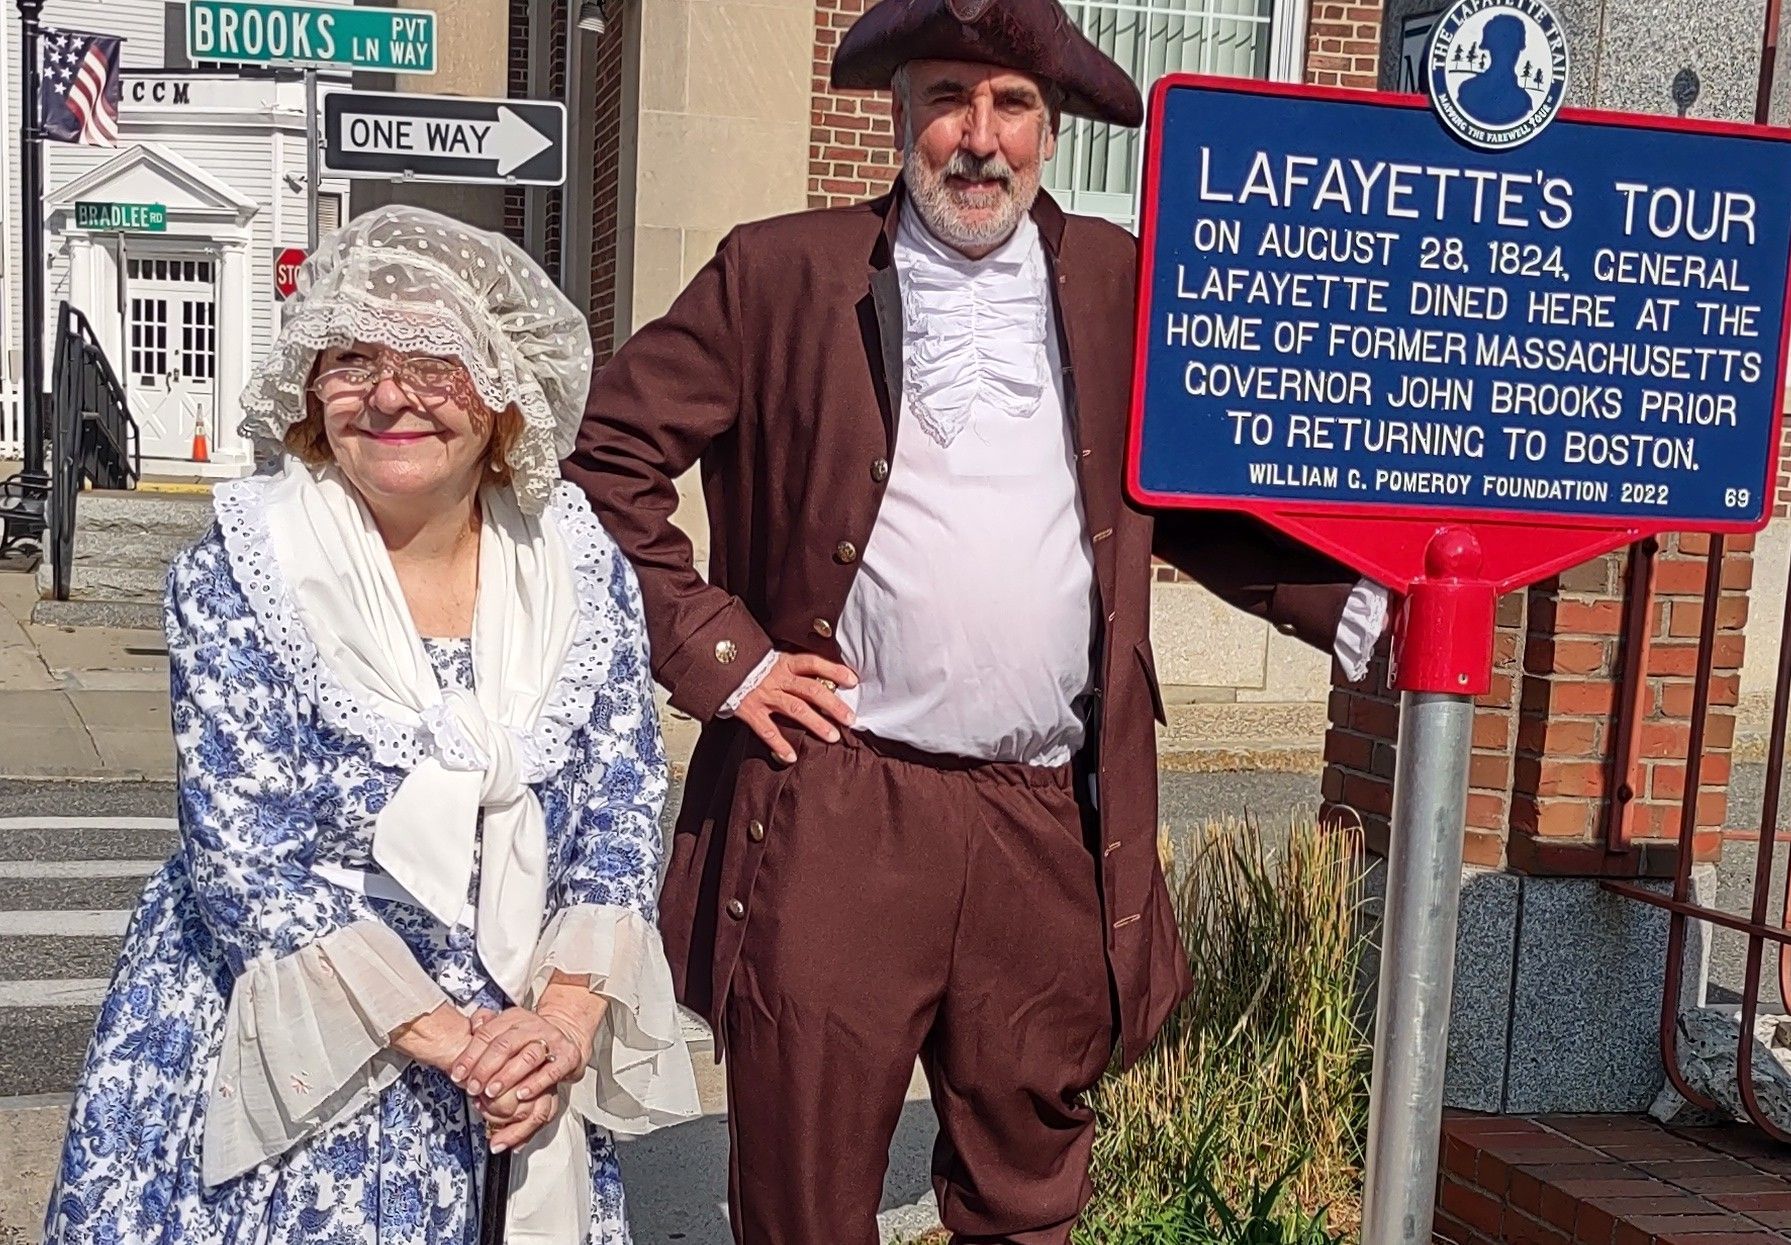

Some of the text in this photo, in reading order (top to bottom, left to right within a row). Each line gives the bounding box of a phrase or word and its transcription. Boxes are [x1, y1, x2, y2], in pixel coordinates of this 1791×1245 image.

[194, 6, 379, 62] BROOKS LN
[390, 41, 428, 66] WAY
[392, 17, 427, 42] PVT
[1433, 29, 1454, 70] THE
[1545, 23, 1566, 84] TRAIL
[350, 118, 491, 154] ONE WAY
[1438, 93, 1467, 131] MAPPING
[1468, 127, 1484, 141] THE
[1486, 124, 1531, 143] FAREWELL
[79, 205, 163, 227] BRADLEE RD
[1200, 147, 1756, 245] LAFAYETTE'S TOUR
[1194, 218, 1751, 292] ON AUGUST 28, 1824, GENERAL
[1177, 264, 1761, 337] LAFAYETTE DINED HERE AT THE
[1166, 313, 1762, 383] HOME OF FORMER MASSACHUSETTS
[1184, 360, 1737, 427] GOVERNOR JOHN BROOKS PRIOR
[1226, 409, 1700, 471] TO RETURNING TO BOSTON.
[1249, 463, 1669, 505] WILLIAM G. POMEROY FOUNDATION 2022
[1724, 487, 1750, 508] 69
